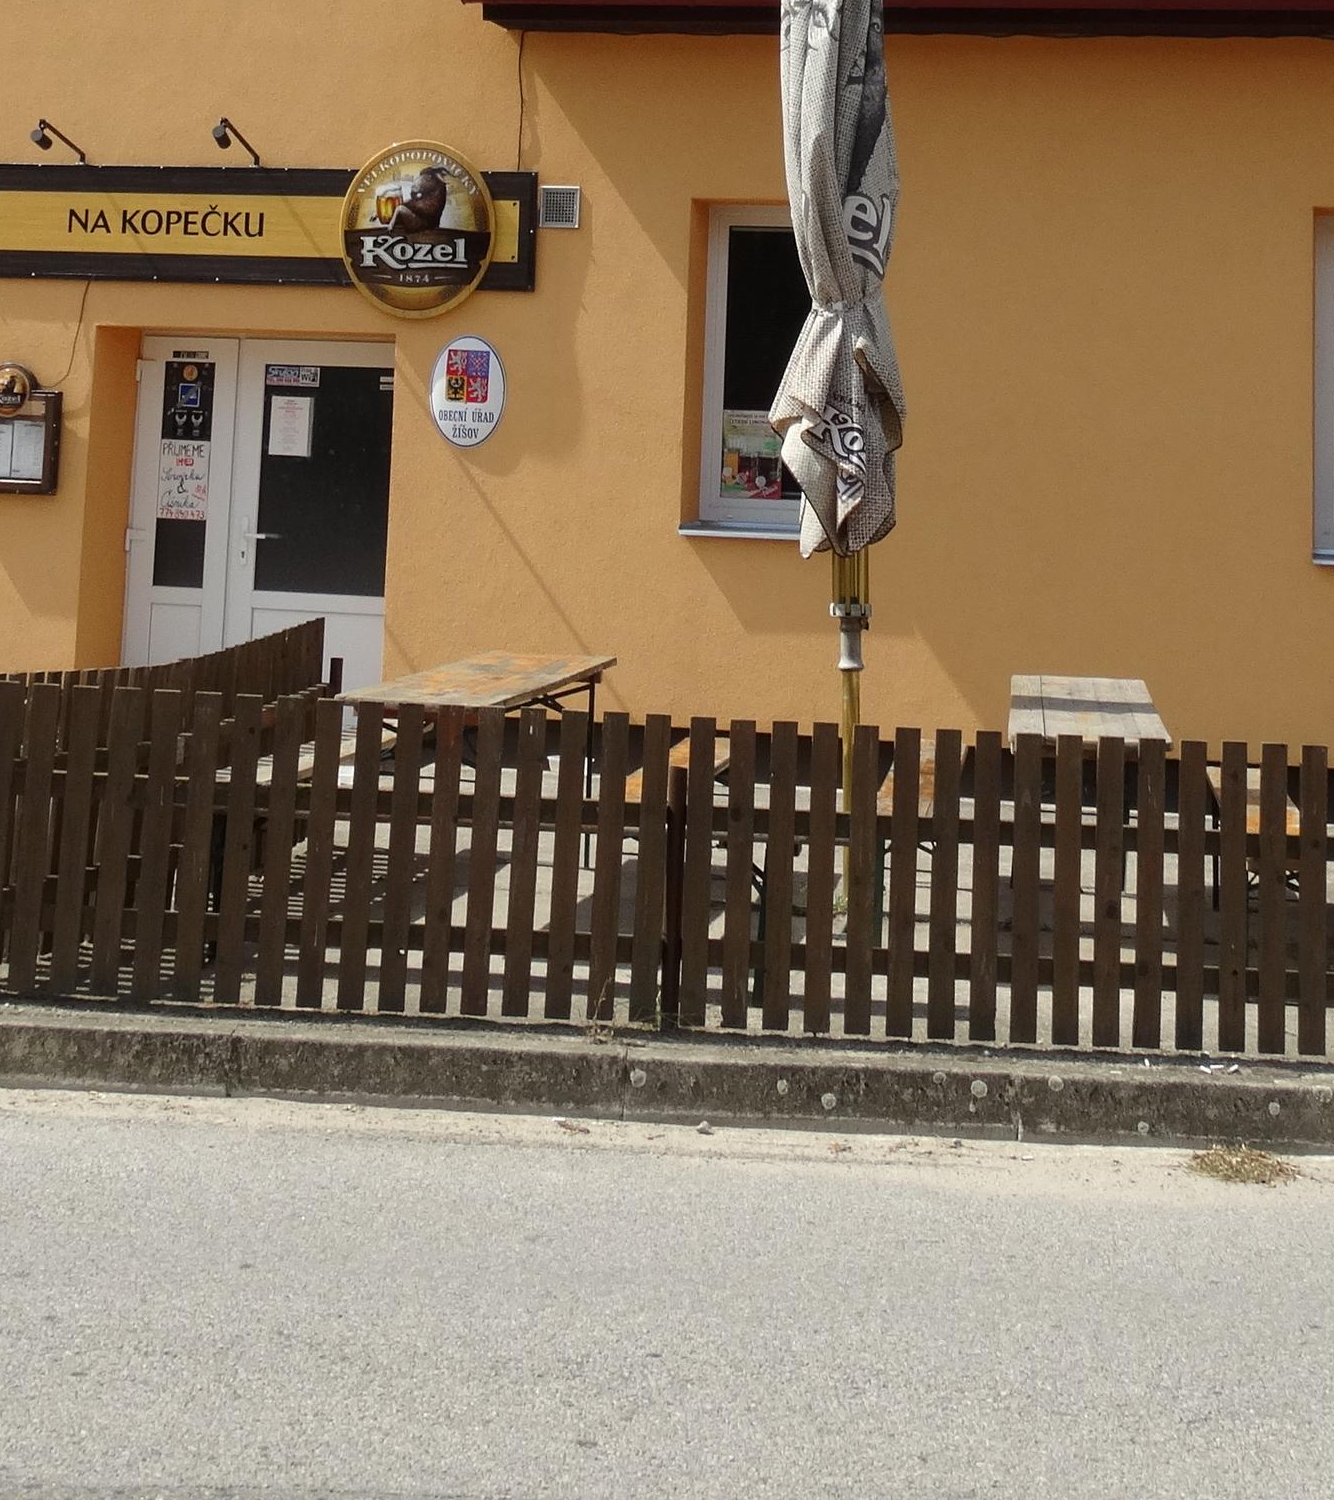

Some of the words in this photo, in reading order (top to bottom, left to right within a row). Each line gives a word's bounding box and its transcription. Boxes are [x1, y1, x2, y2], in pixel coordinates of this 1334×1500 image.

[68, 208, 111, 234] NA
[121, 204, 265, 238] KOPEČKU
[360, 235, 468, 269] Kozel
[399, 274, 430, 284] 1874
[438, 407, 468, 422] OBECNÍ
[472, 408, 495, 424] ÚŘAD
[451, 424, 479, 439] ŽÍŠOV
